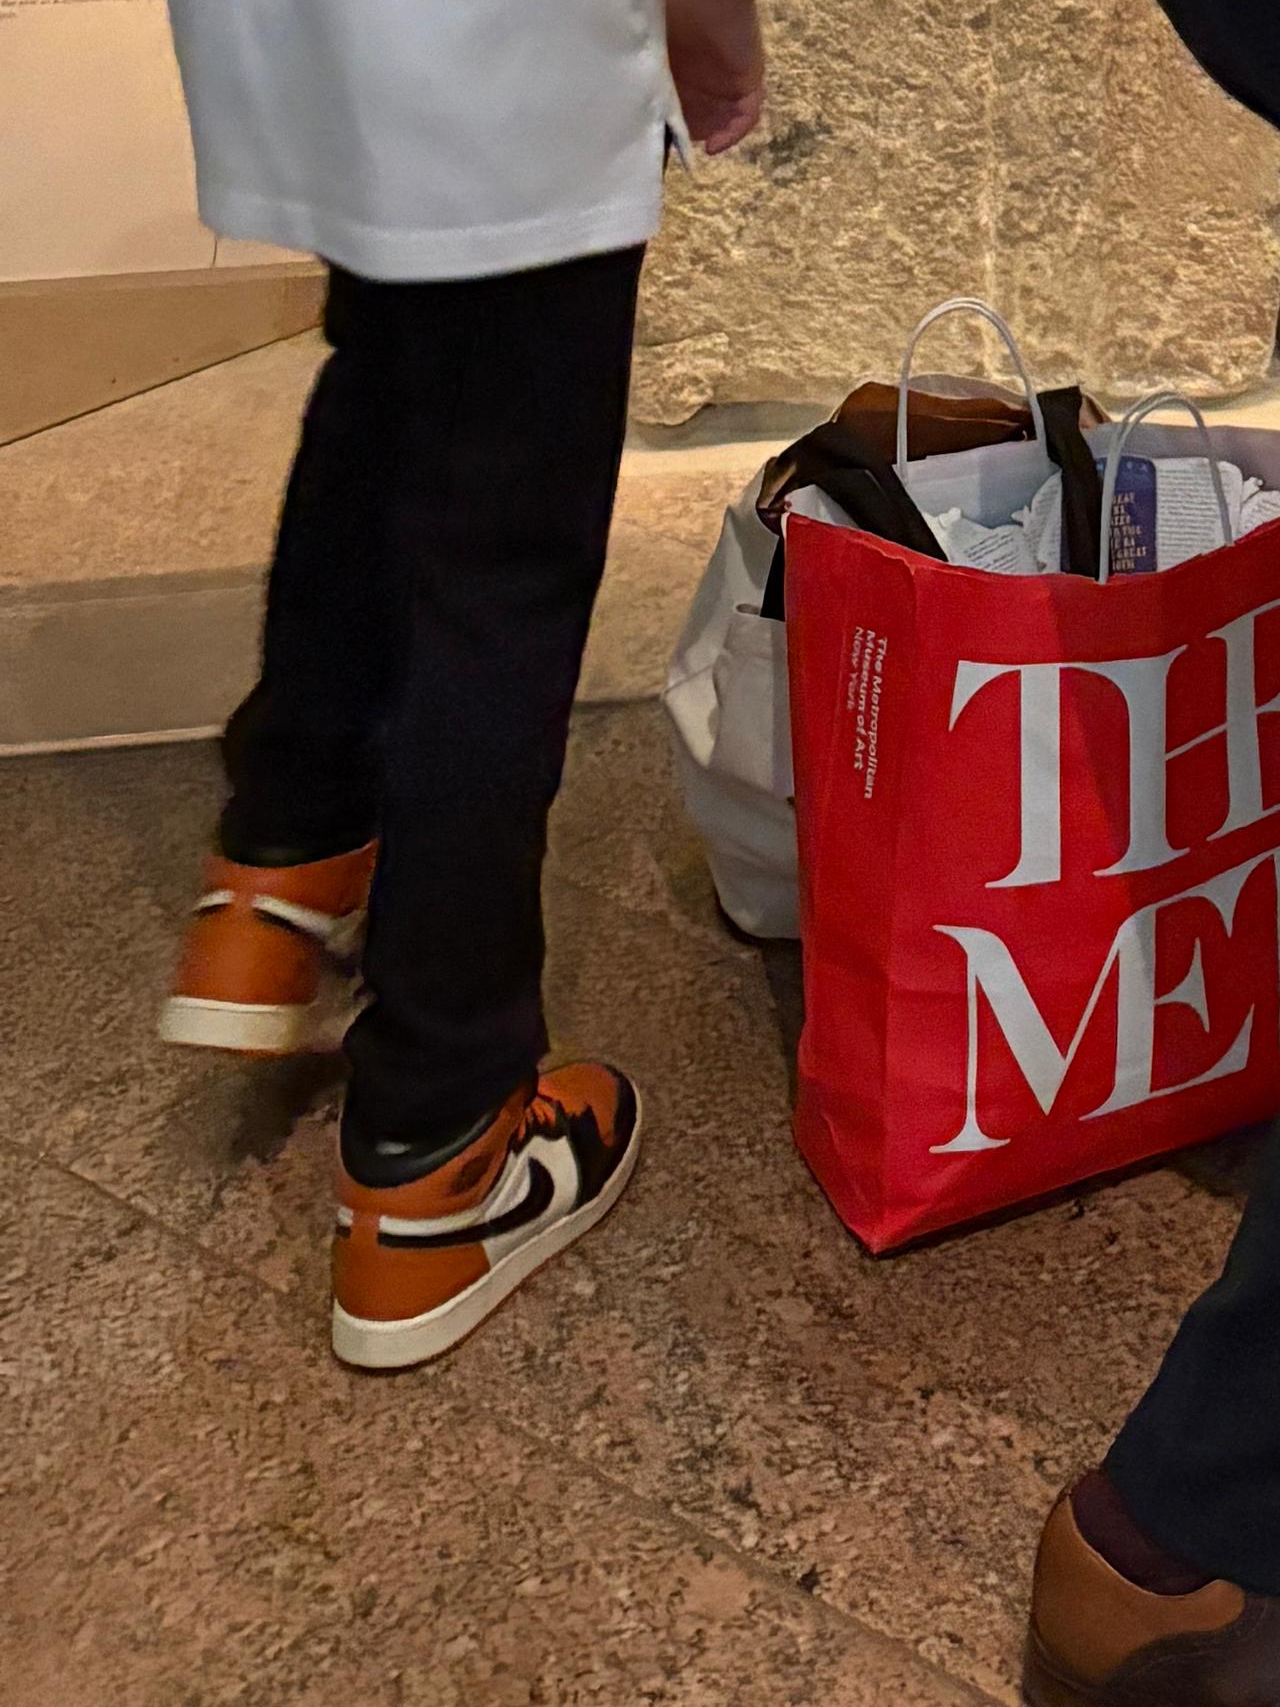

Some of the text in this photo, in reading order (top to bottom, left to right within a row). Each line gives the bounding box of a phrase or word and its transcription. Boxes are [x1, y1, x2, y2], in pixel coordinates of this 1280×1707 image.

[851, 625, 864, 669] New
[854, 629, 876, 771] Museum of Art
[864, 636, 888, 800] The Metropolitan
